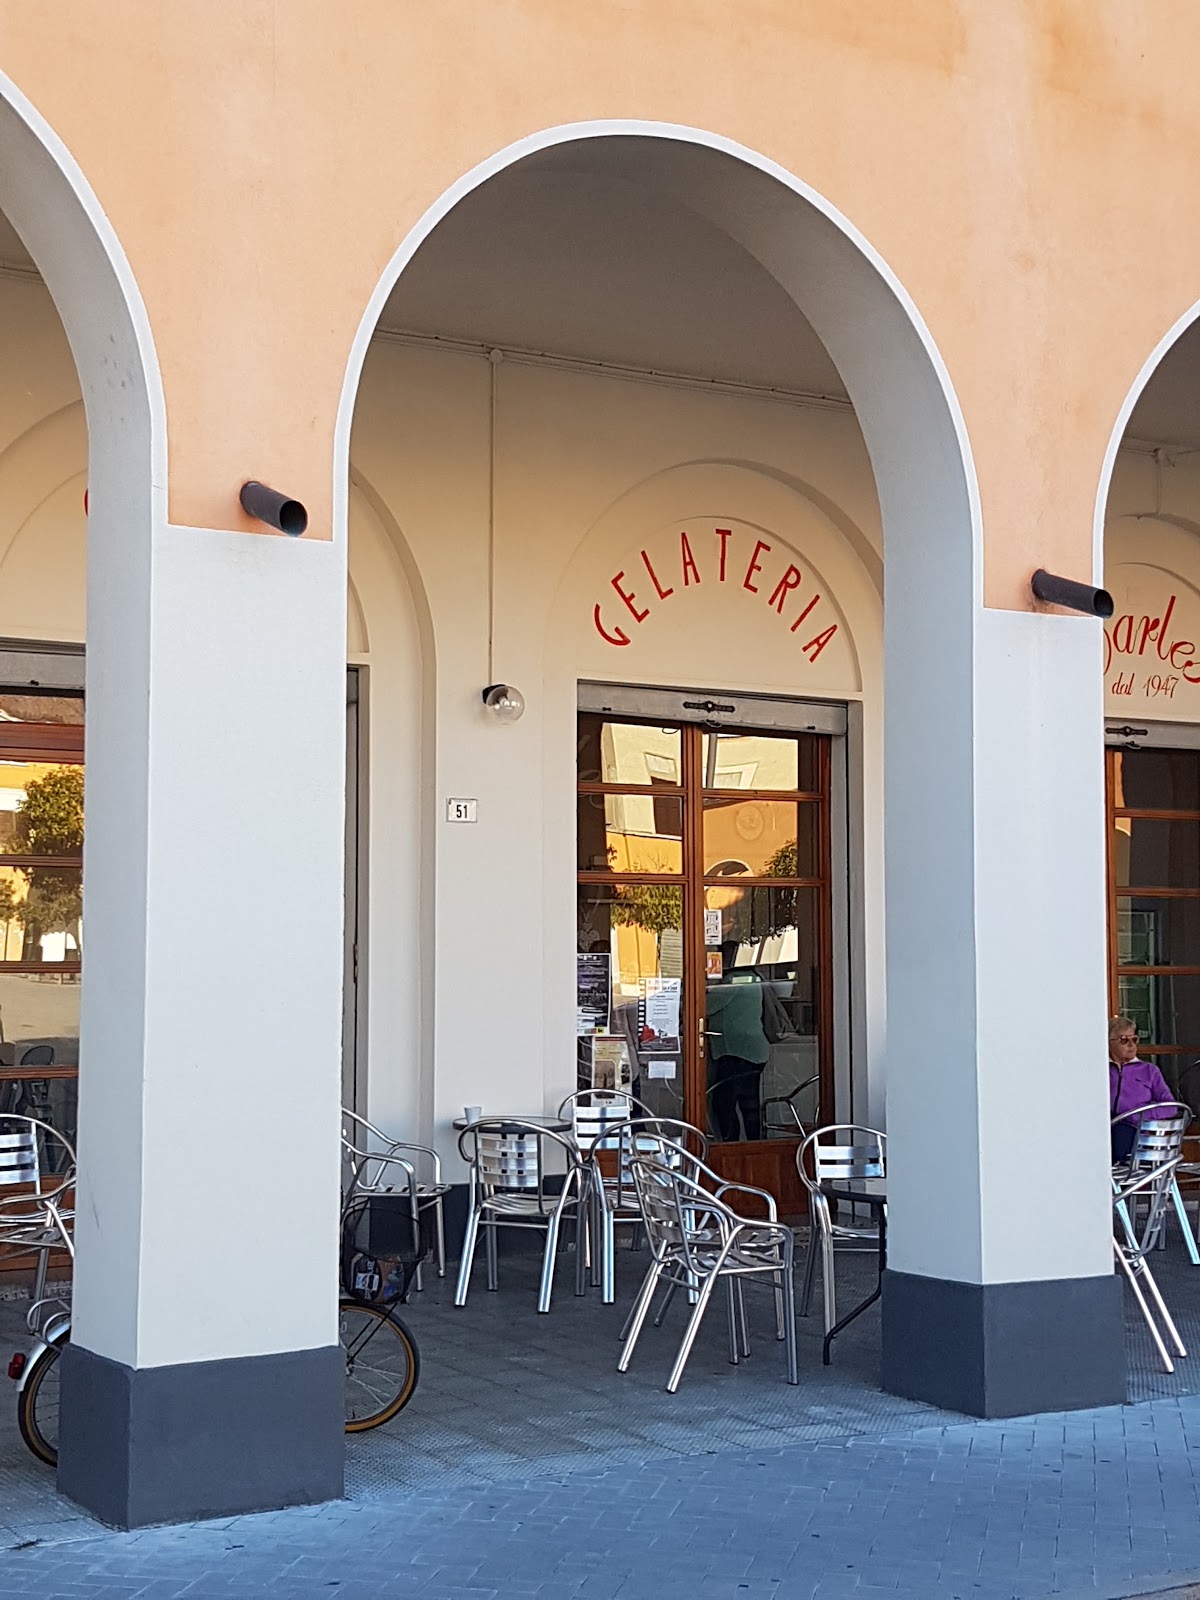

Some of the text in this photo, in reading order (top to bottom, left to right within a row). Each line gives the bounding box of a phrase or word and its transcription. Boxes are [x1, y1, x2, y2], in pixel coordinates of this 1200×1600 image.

[594, 528, 838, 663] GELATERIA
[1112, 672, 1179, 699] dal 1947
[456, 804, 468, 819] 51
